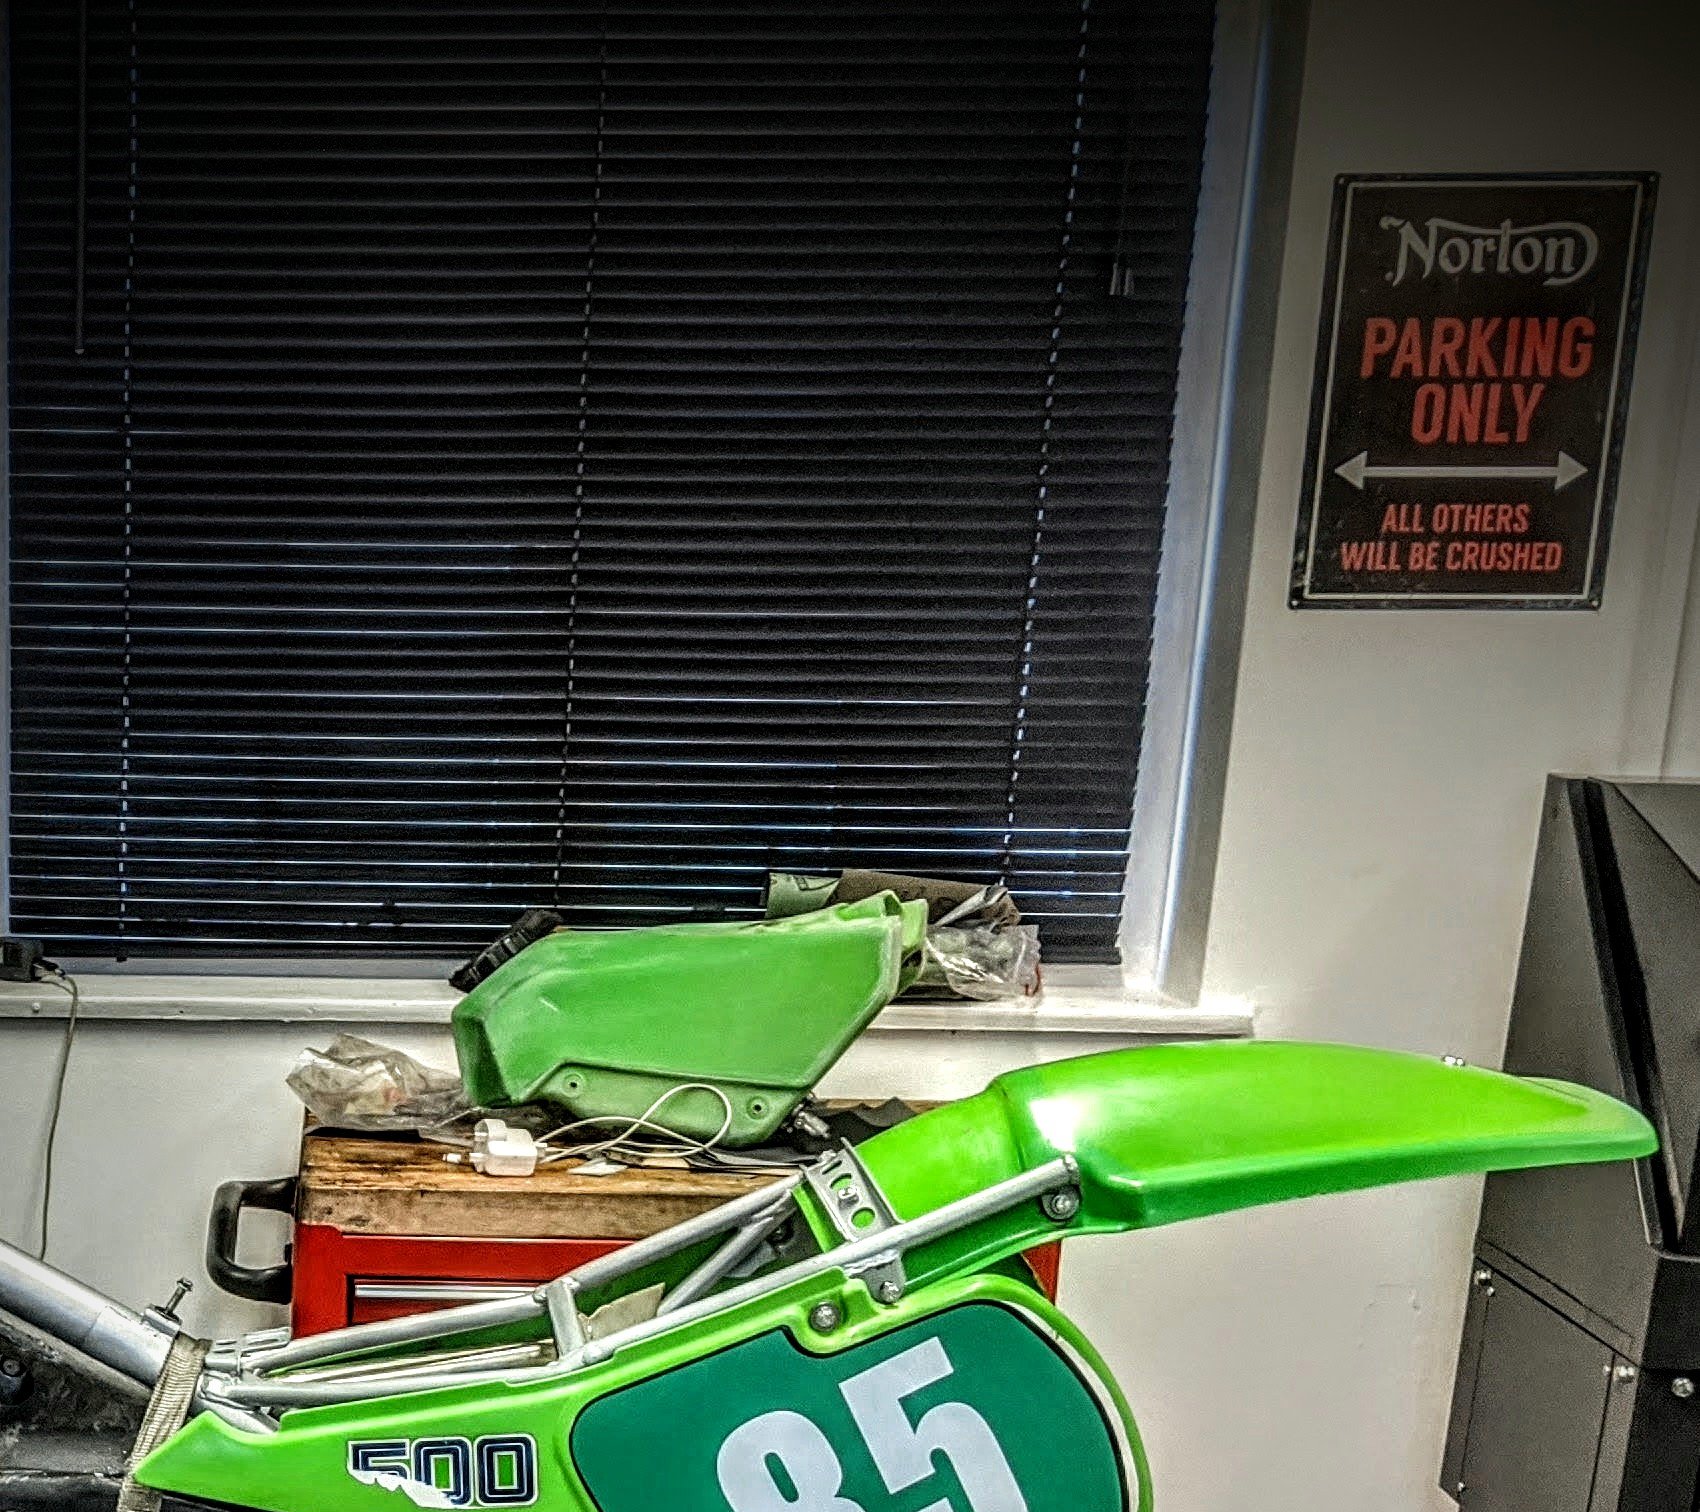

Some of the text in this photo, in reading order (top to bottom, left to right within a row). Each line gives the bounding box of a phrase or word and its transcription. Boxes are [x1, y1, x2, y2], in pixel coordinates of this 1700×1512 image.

[1379, 216, 1599, 287] Norton
[1360, 317, 1597, 379] PARKING
[1411, 383, 1545, 445] ONLY
[1381, 503, 1531, 533] ALL OTHERS
[1340, 541, 1563, 571] WILL BE CRUSHED
[347, 1433, 539, 1509] 500
